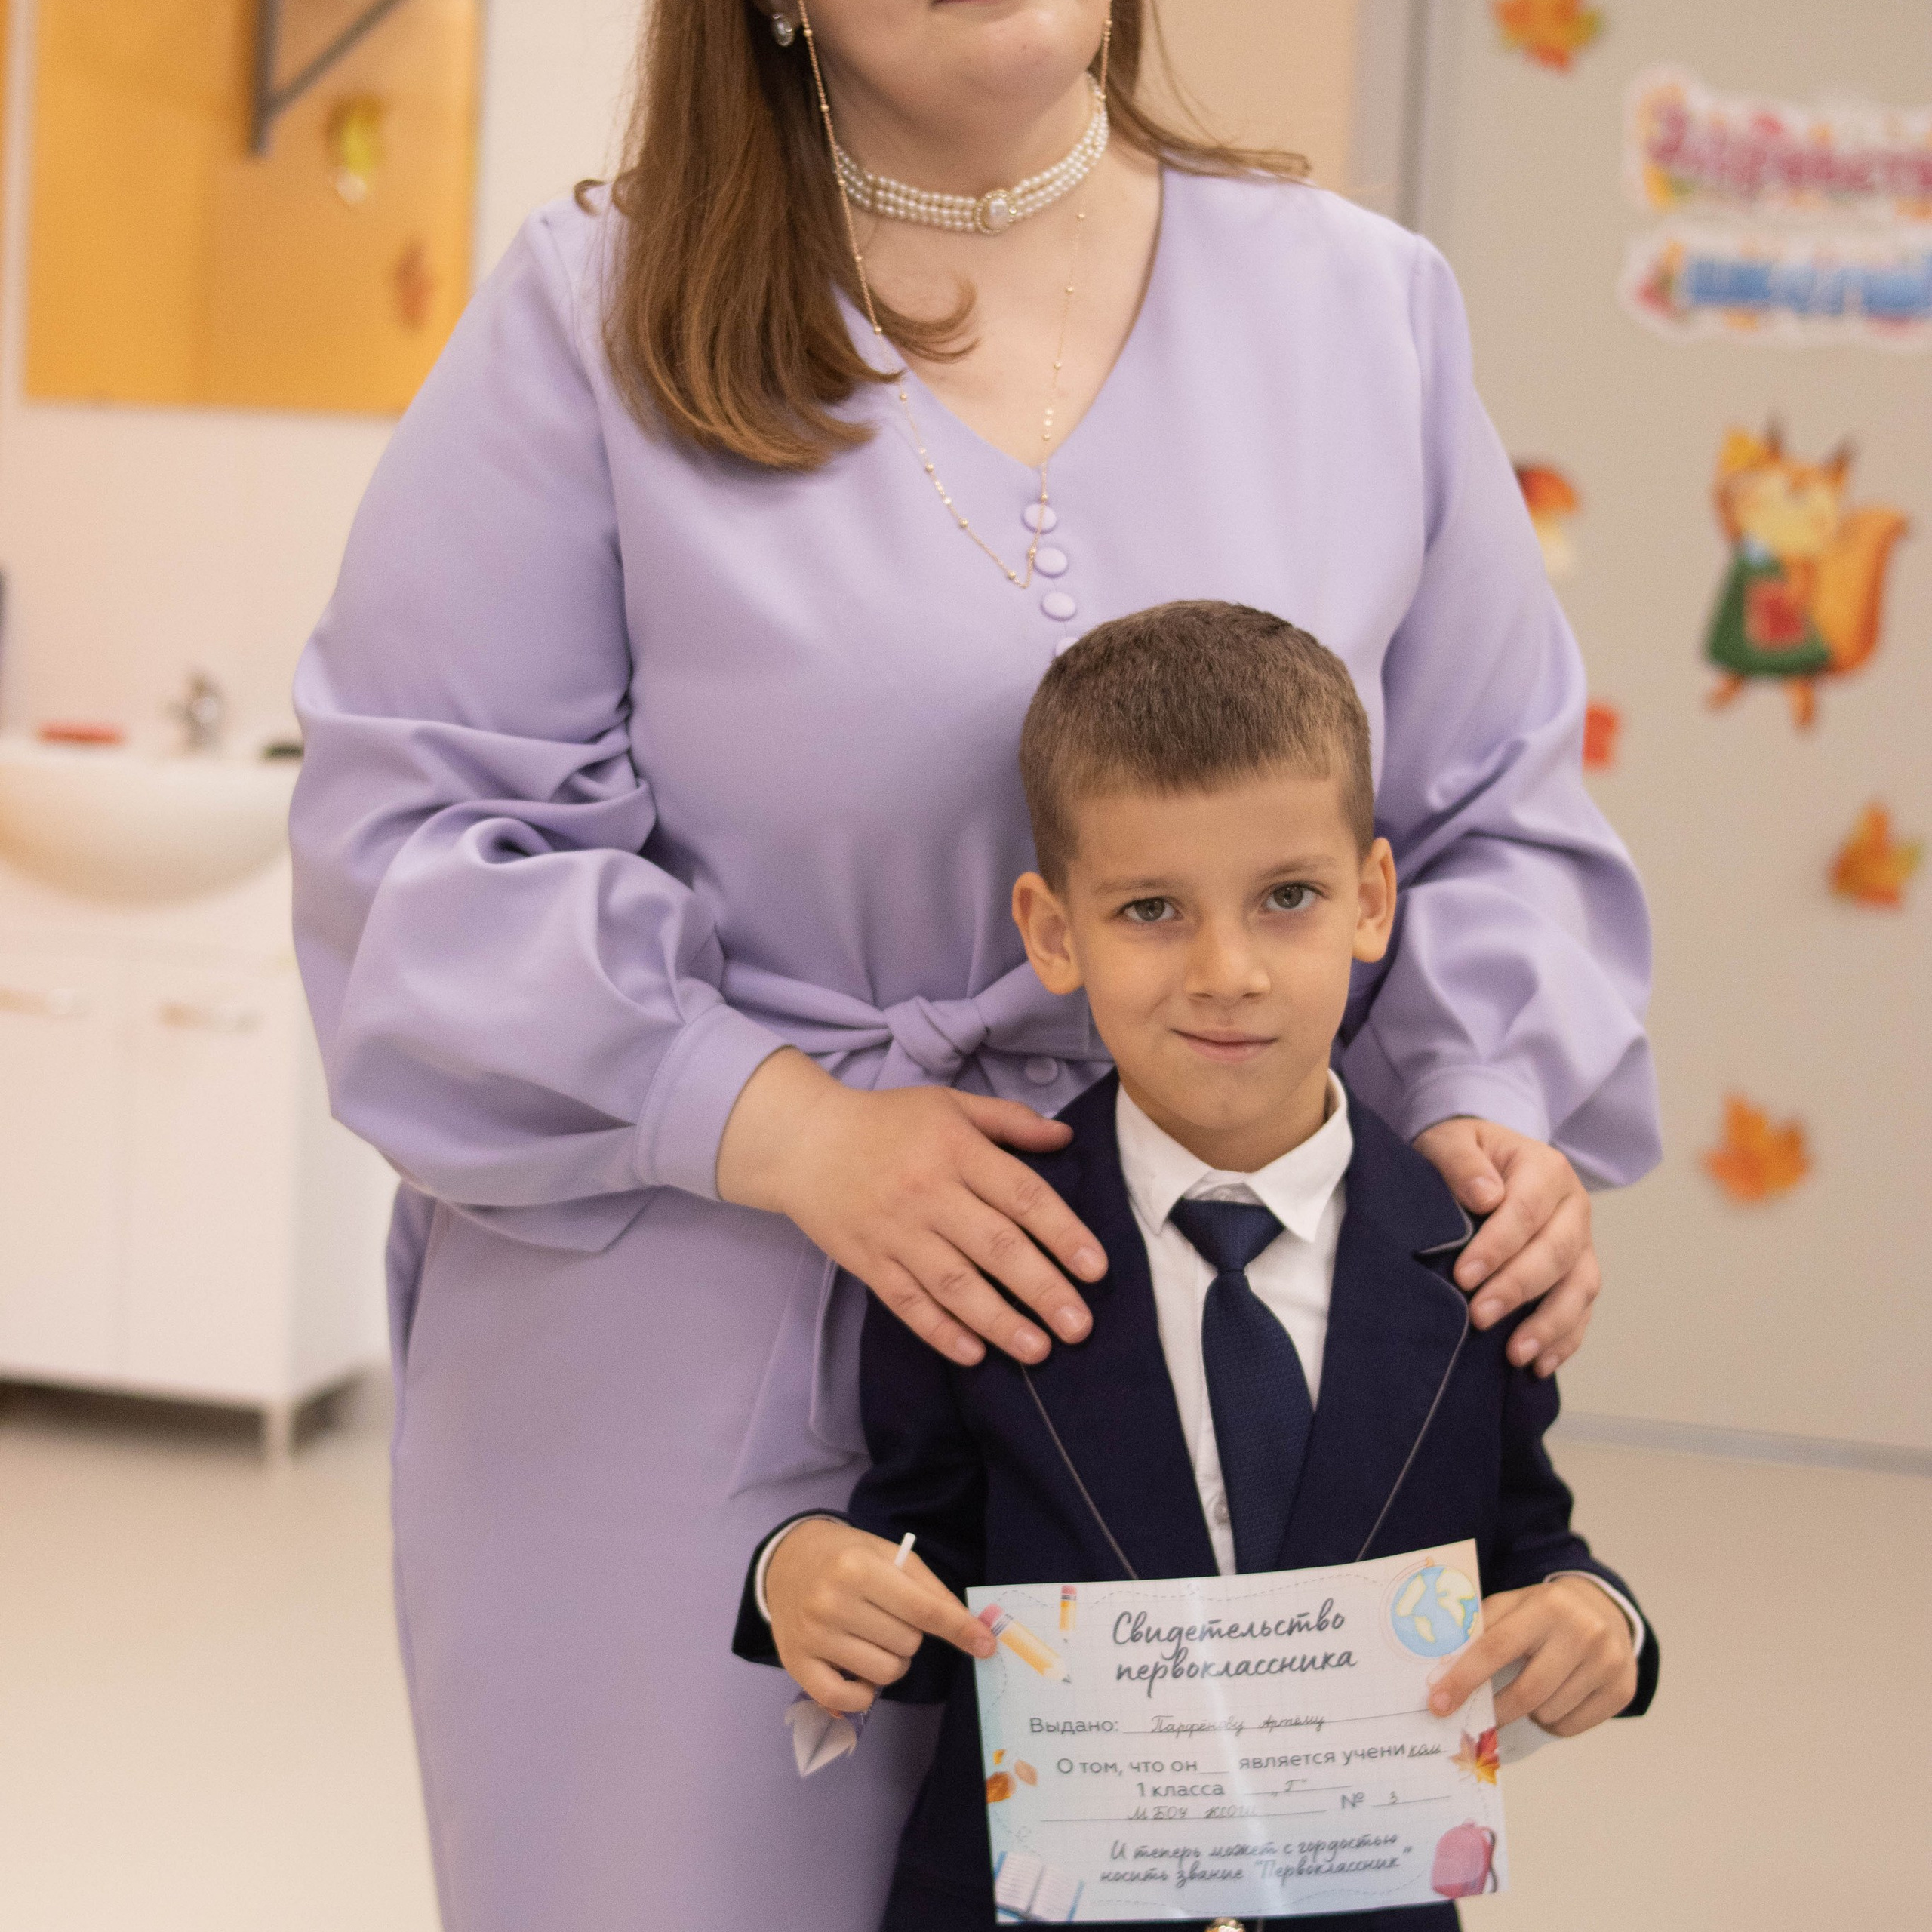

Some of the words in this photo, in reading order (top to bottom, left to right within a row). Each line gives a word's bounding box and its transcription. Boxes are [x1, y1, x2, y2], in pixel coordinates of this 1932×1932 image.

[1112, 1598, 1346, 1660] Свидетельство
[1115, 1647, 1358, 1698] первоклассника
[1029, 1717, 1119, 1735] Выдано:
[1057, 1758, 1073, 1774] О
[1079, 1761, 1123, 1776] том,
[1129, 1761, 1164, 1774] что
[1171, 1760, 1197, 1773] он
[1238, 1750, 1336, 1770] является
[1137, 1782, 1145, 1798] 1
[1152, 1783, 1225, 1798] класса
[1341, 1791, 1364, 1810] №
[1389, 1790, 1398, 1805] 3
[1110, 1840, 1128, 1860] И
[1134, 1845, 1201, 1869] теперь
[1208, 1841, 1278, 1859] может
[1284, 1842, 1292, 1854] с
[1297, 1833, 1398, 1863] гордостью
[1100, 1867, 1169, 1882] носить
[1176, 1860, 1244, 1889] звание
